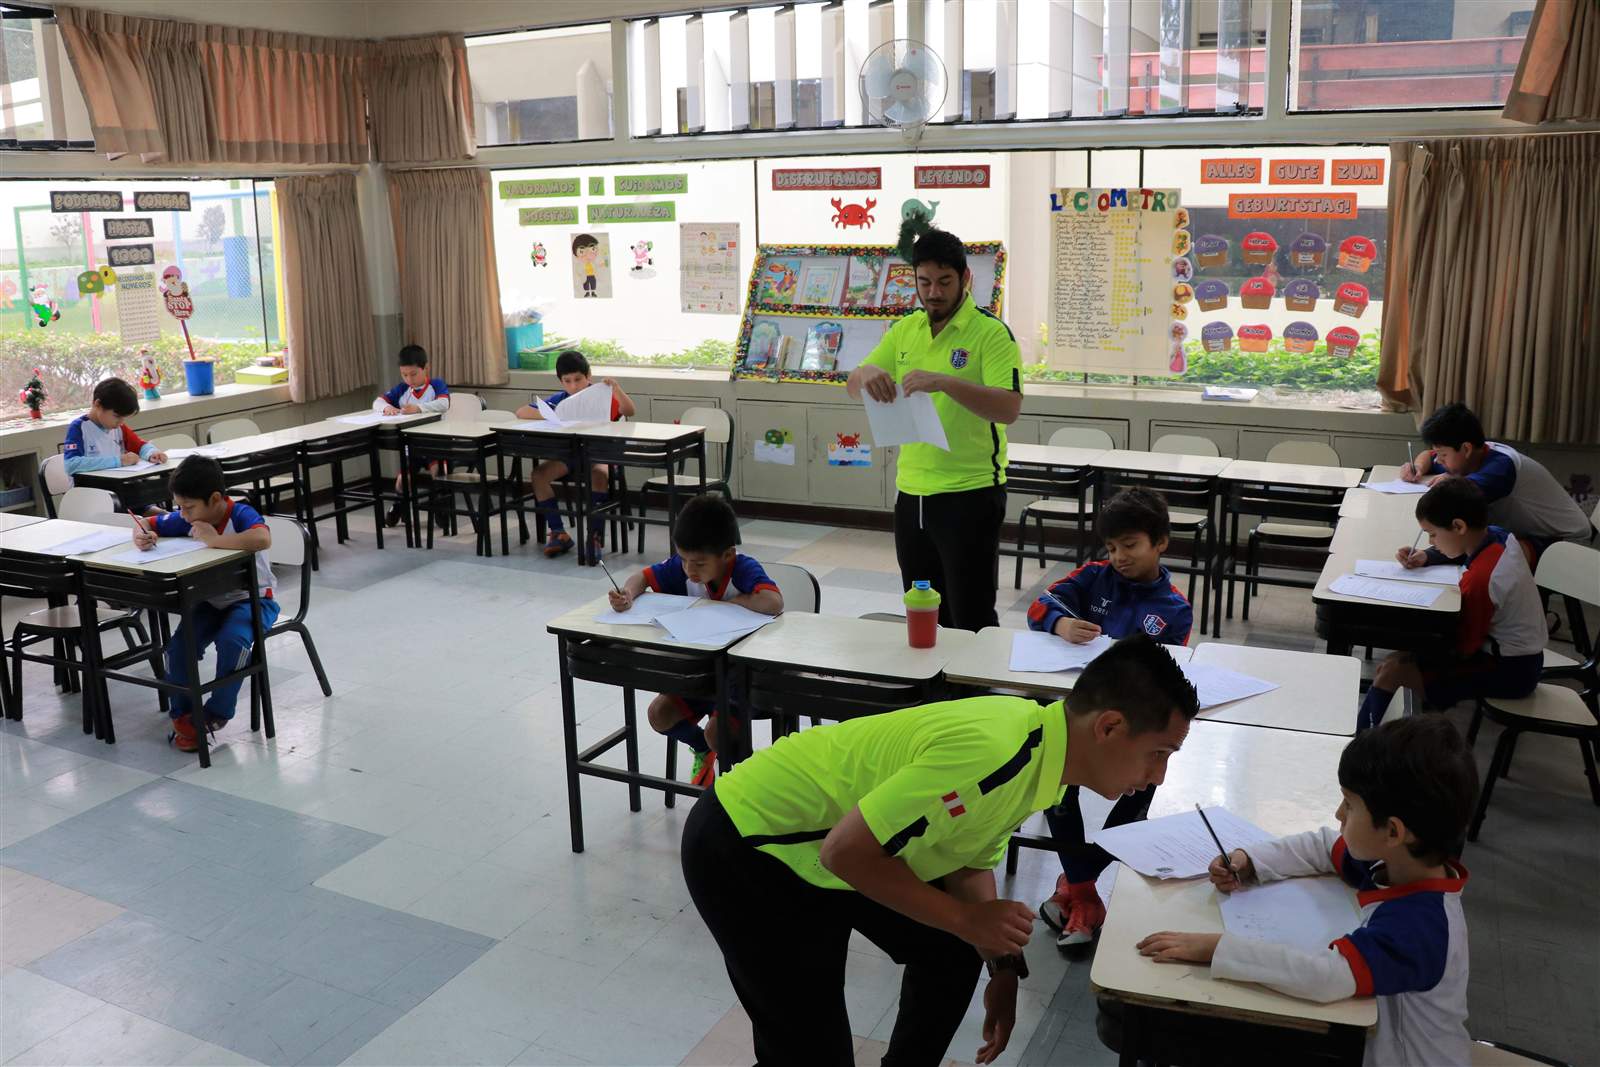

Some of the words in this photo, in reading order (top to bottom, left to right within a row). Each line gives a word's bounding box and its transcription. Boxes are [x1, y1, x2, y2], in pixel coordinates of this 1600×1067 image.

[776, 171, 877, 186] DISFRUTAMOS
[919, 169, 985, 184] LEYENDO
[1207, 163, 1256, 179] ALLES
[1276, 164, 1319, 180] GUTE
[1337, 164, 1378, 180] ZUM
[593, 182, 600, 193] Y
[53, 193, 120, 210] PODEMOS
[1234, 197, 1352, 214] GEBURTSTAG!
[107, 220, 151, 237] HASTA
[111, 248, 153, 265] 1000
